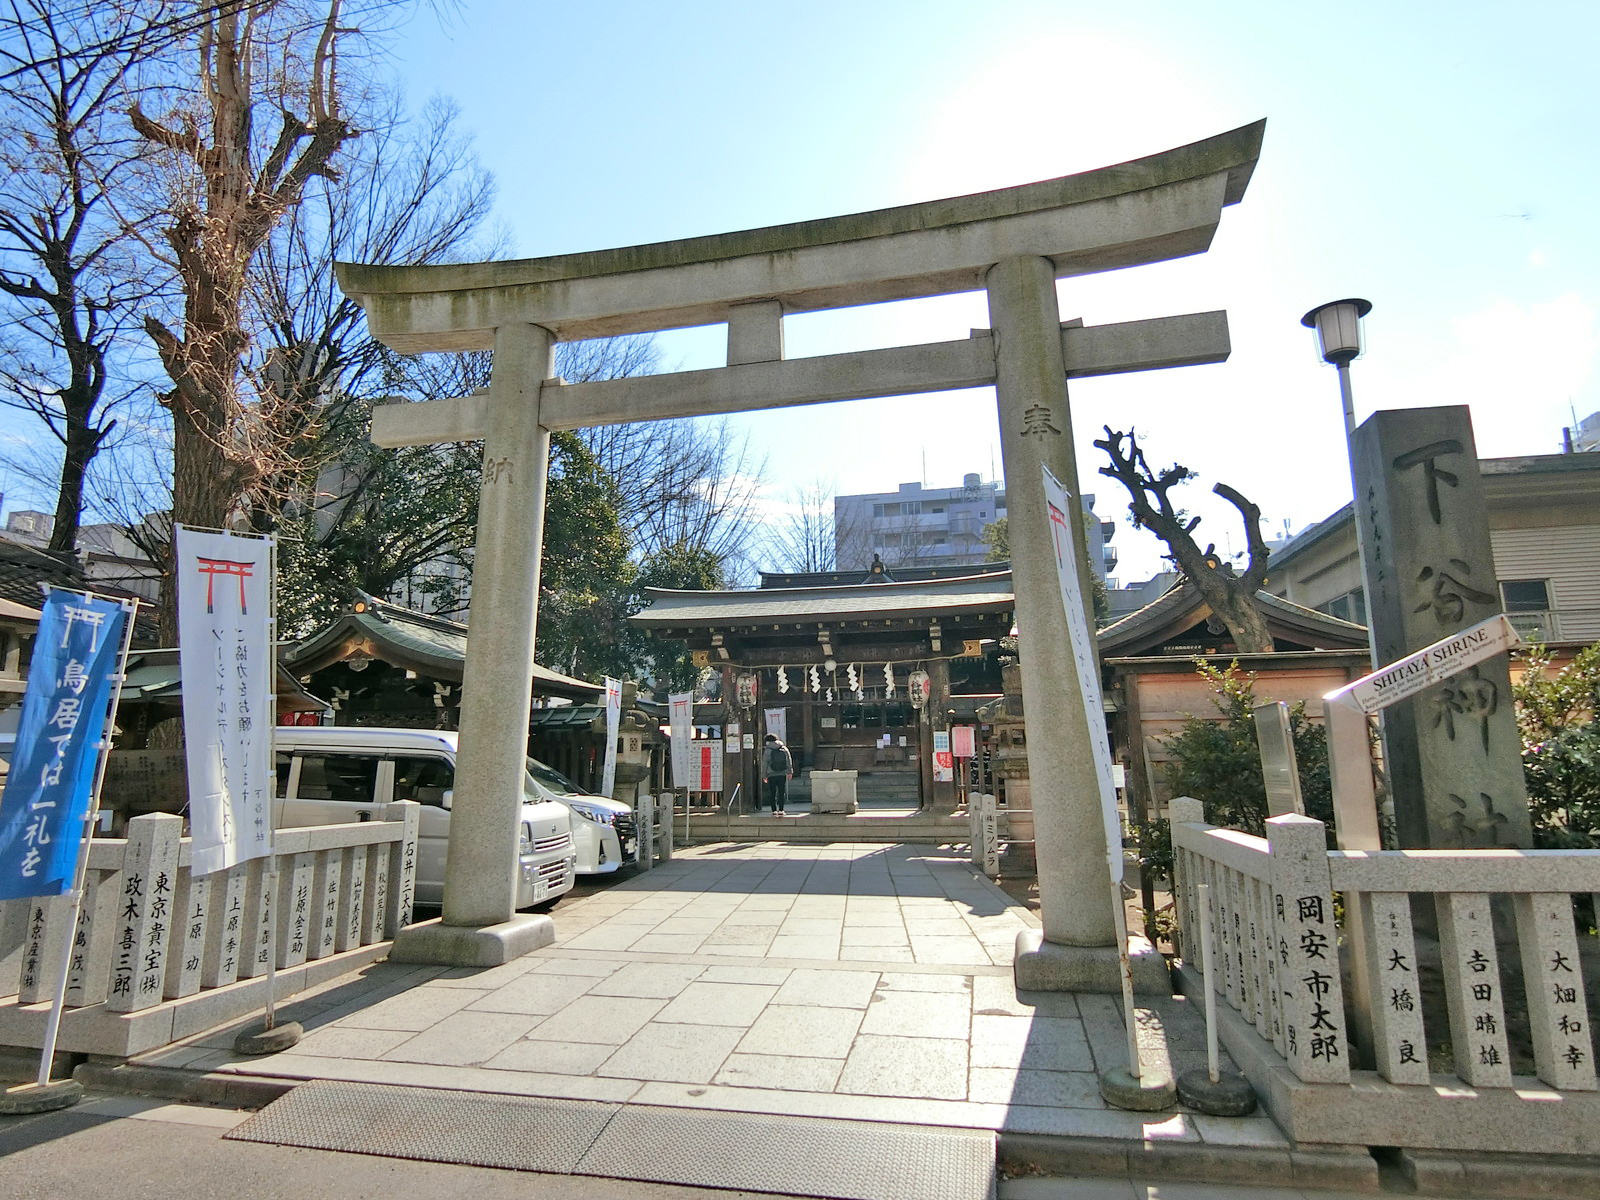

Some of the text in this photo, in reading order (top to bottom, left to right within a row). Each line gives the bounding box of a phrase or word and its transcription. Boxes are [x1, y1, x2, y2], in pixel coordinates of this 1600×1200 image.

[1373, 628, 1488, 692] SHITAYA SHRINE
[1472, 639, 1497, 653] harmony
[21, 657, 89, 878] 鳥居では一礼を
[69, 909, 90, 990] 小島茂二
[113, 873, 143, 998] 政木喜三郎
[186, 903, 204, 971] 上原功
[1276, 894, 1297, 1056] 岡安一男
[1297, 895, 1339, 1063] 岡安市太郎
[1388, 948, 1421, 1064] 大橋良
[1551, 950, 1585, 1070] 大畑和幸
